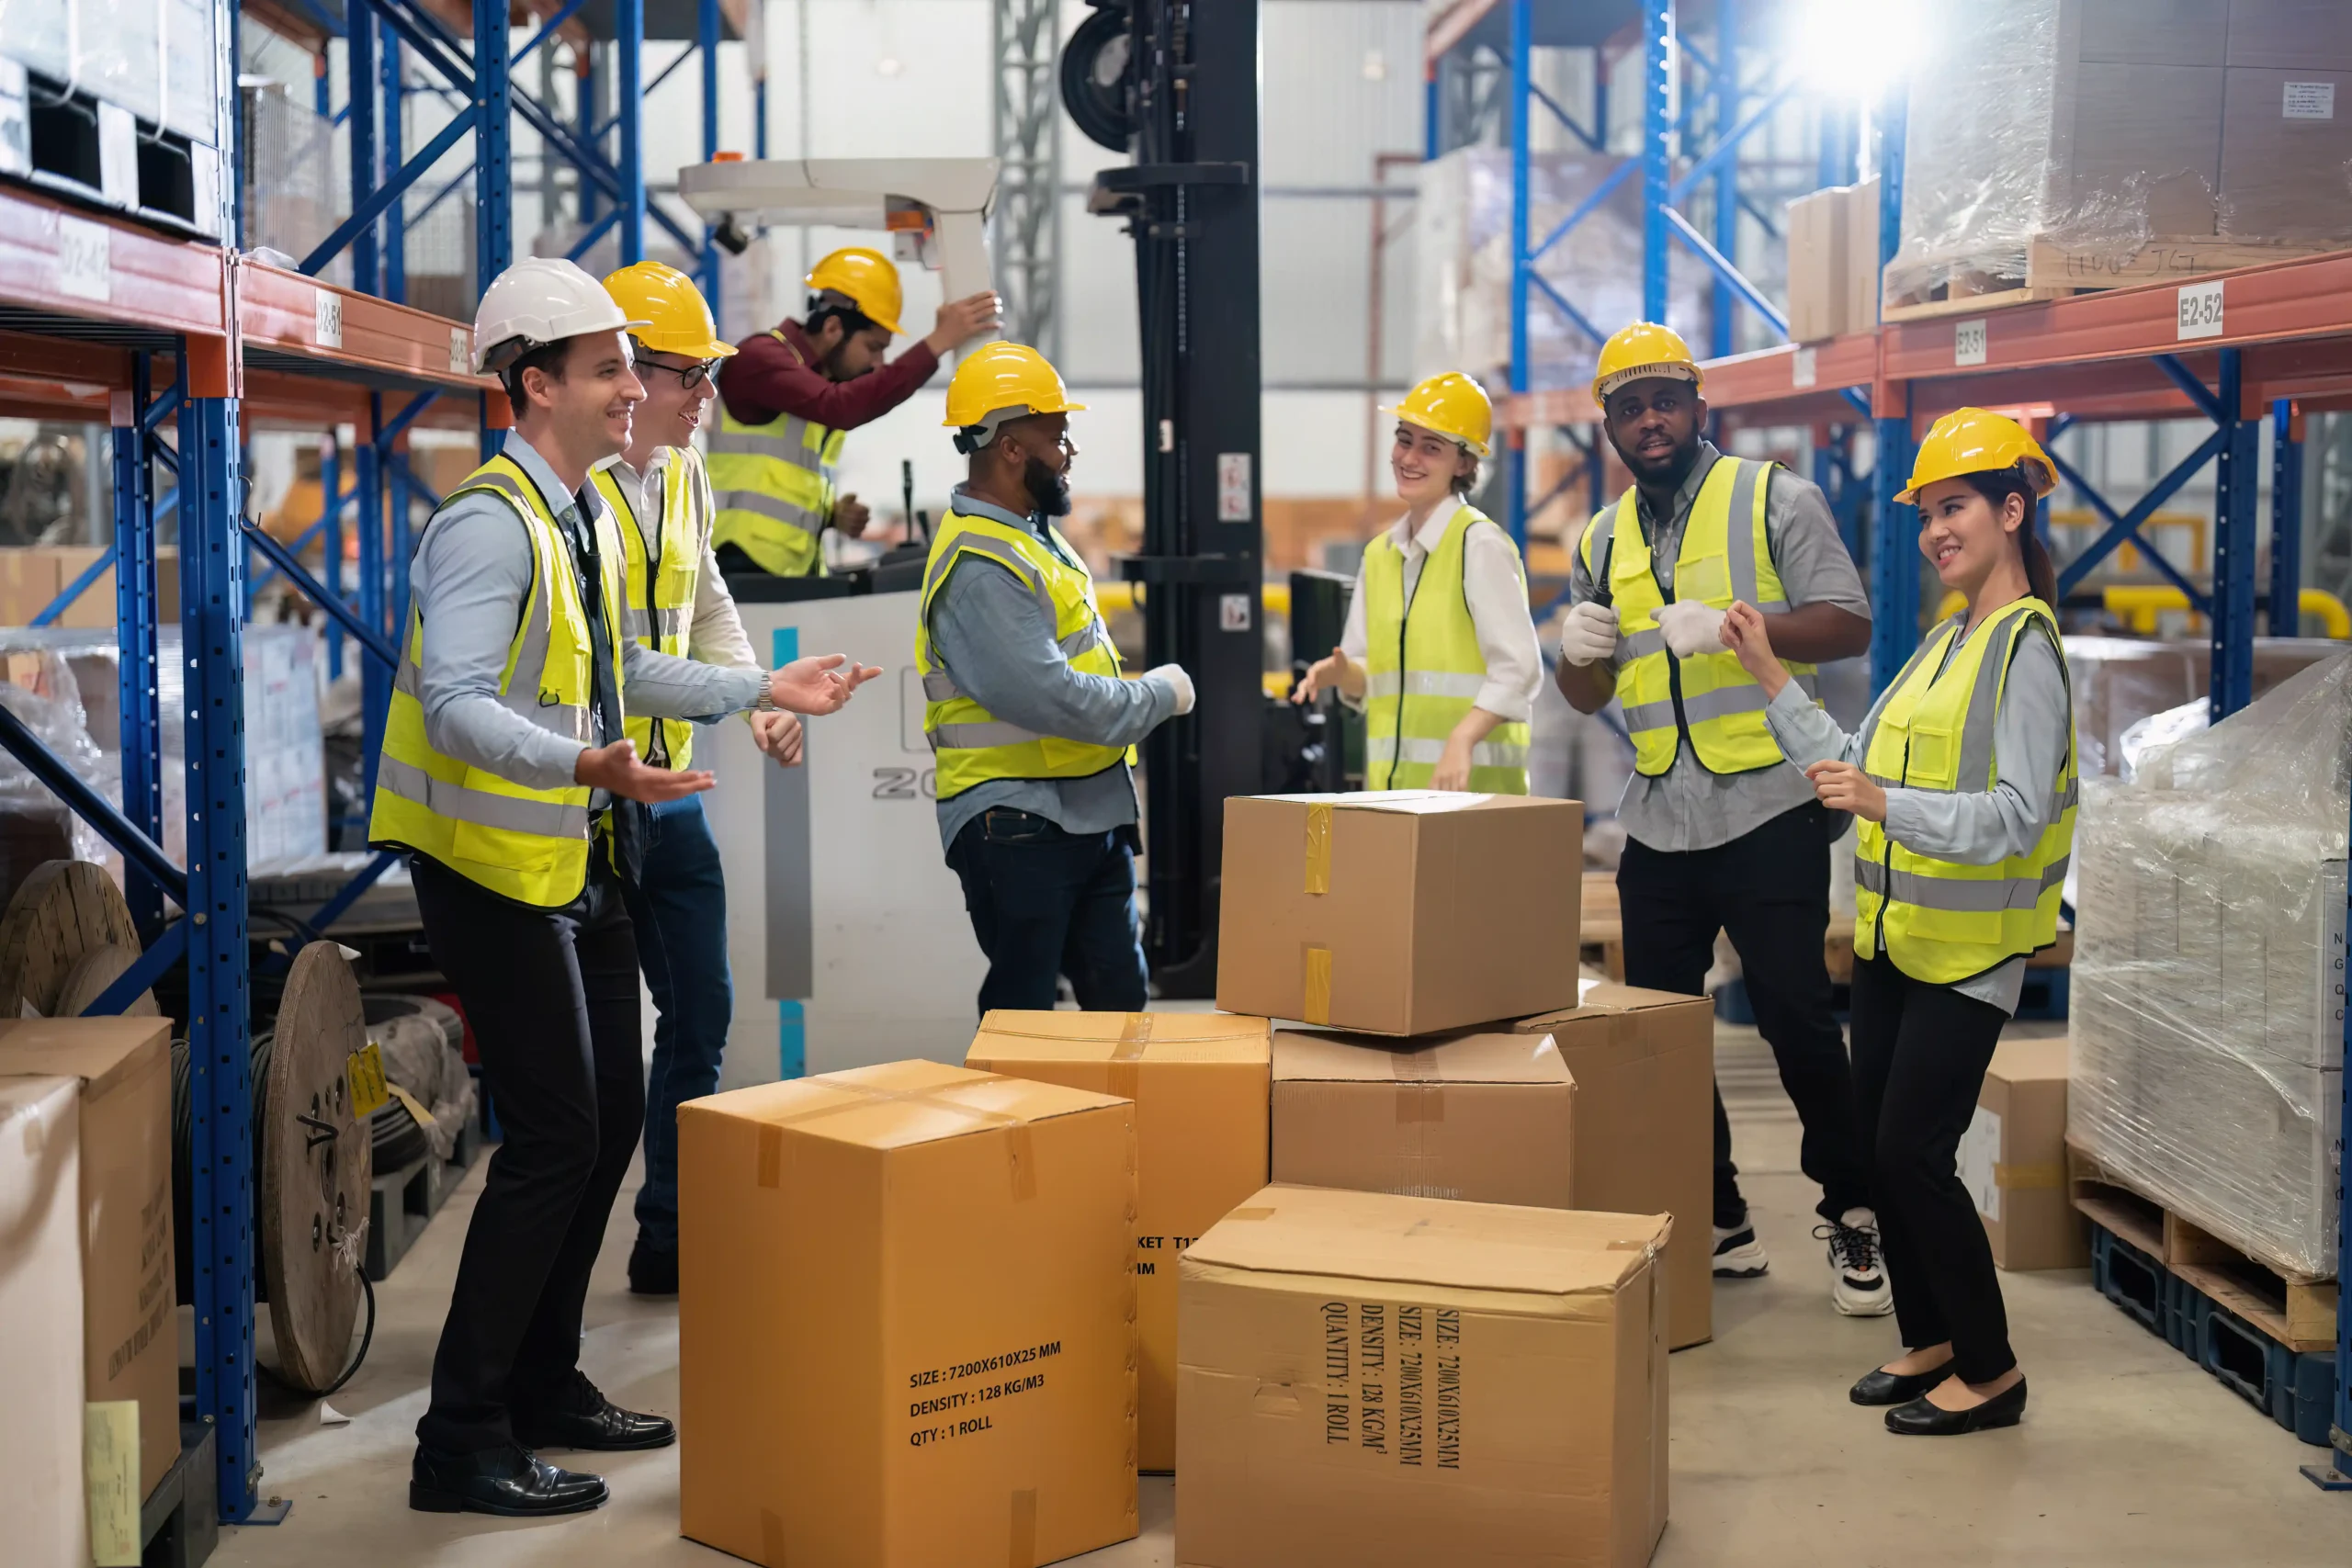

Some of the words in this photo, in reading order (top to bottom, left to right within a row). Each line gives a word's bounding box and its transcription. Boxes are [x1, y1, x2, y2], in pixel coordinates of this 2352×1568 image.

[2179, 292, 2223, 328] E2-52
[1958, 328, 1984, 355] E2-51
[1319, 1302, 1350, 1388] QUANTITY:
[1398, 1305, 1422, 1347] SIZE:
[1436, 1308, 1460, 1350] SIZE:
[949, 1347, 1036, 1381] 7200X610X25
[1038, 1340, 1062, 1359] MM
[978, 1384, 1001, 1402] 128
[1003, 1373, 1046, 1396] KG/M3
[1328, 1392, 1350, 1400] 1
[1362, 1382, 1384, 1404] 128
[948, 1425, 956, 1438] 1
[958, 1416, 993, 1436] ROLL
[1326, 1403, 1350, 1445] ROLL
[1399, 1352, 1423, 1467] 7200X610X25MM
[1437, 1355, 1461, 1470] 7200X610X25MM
